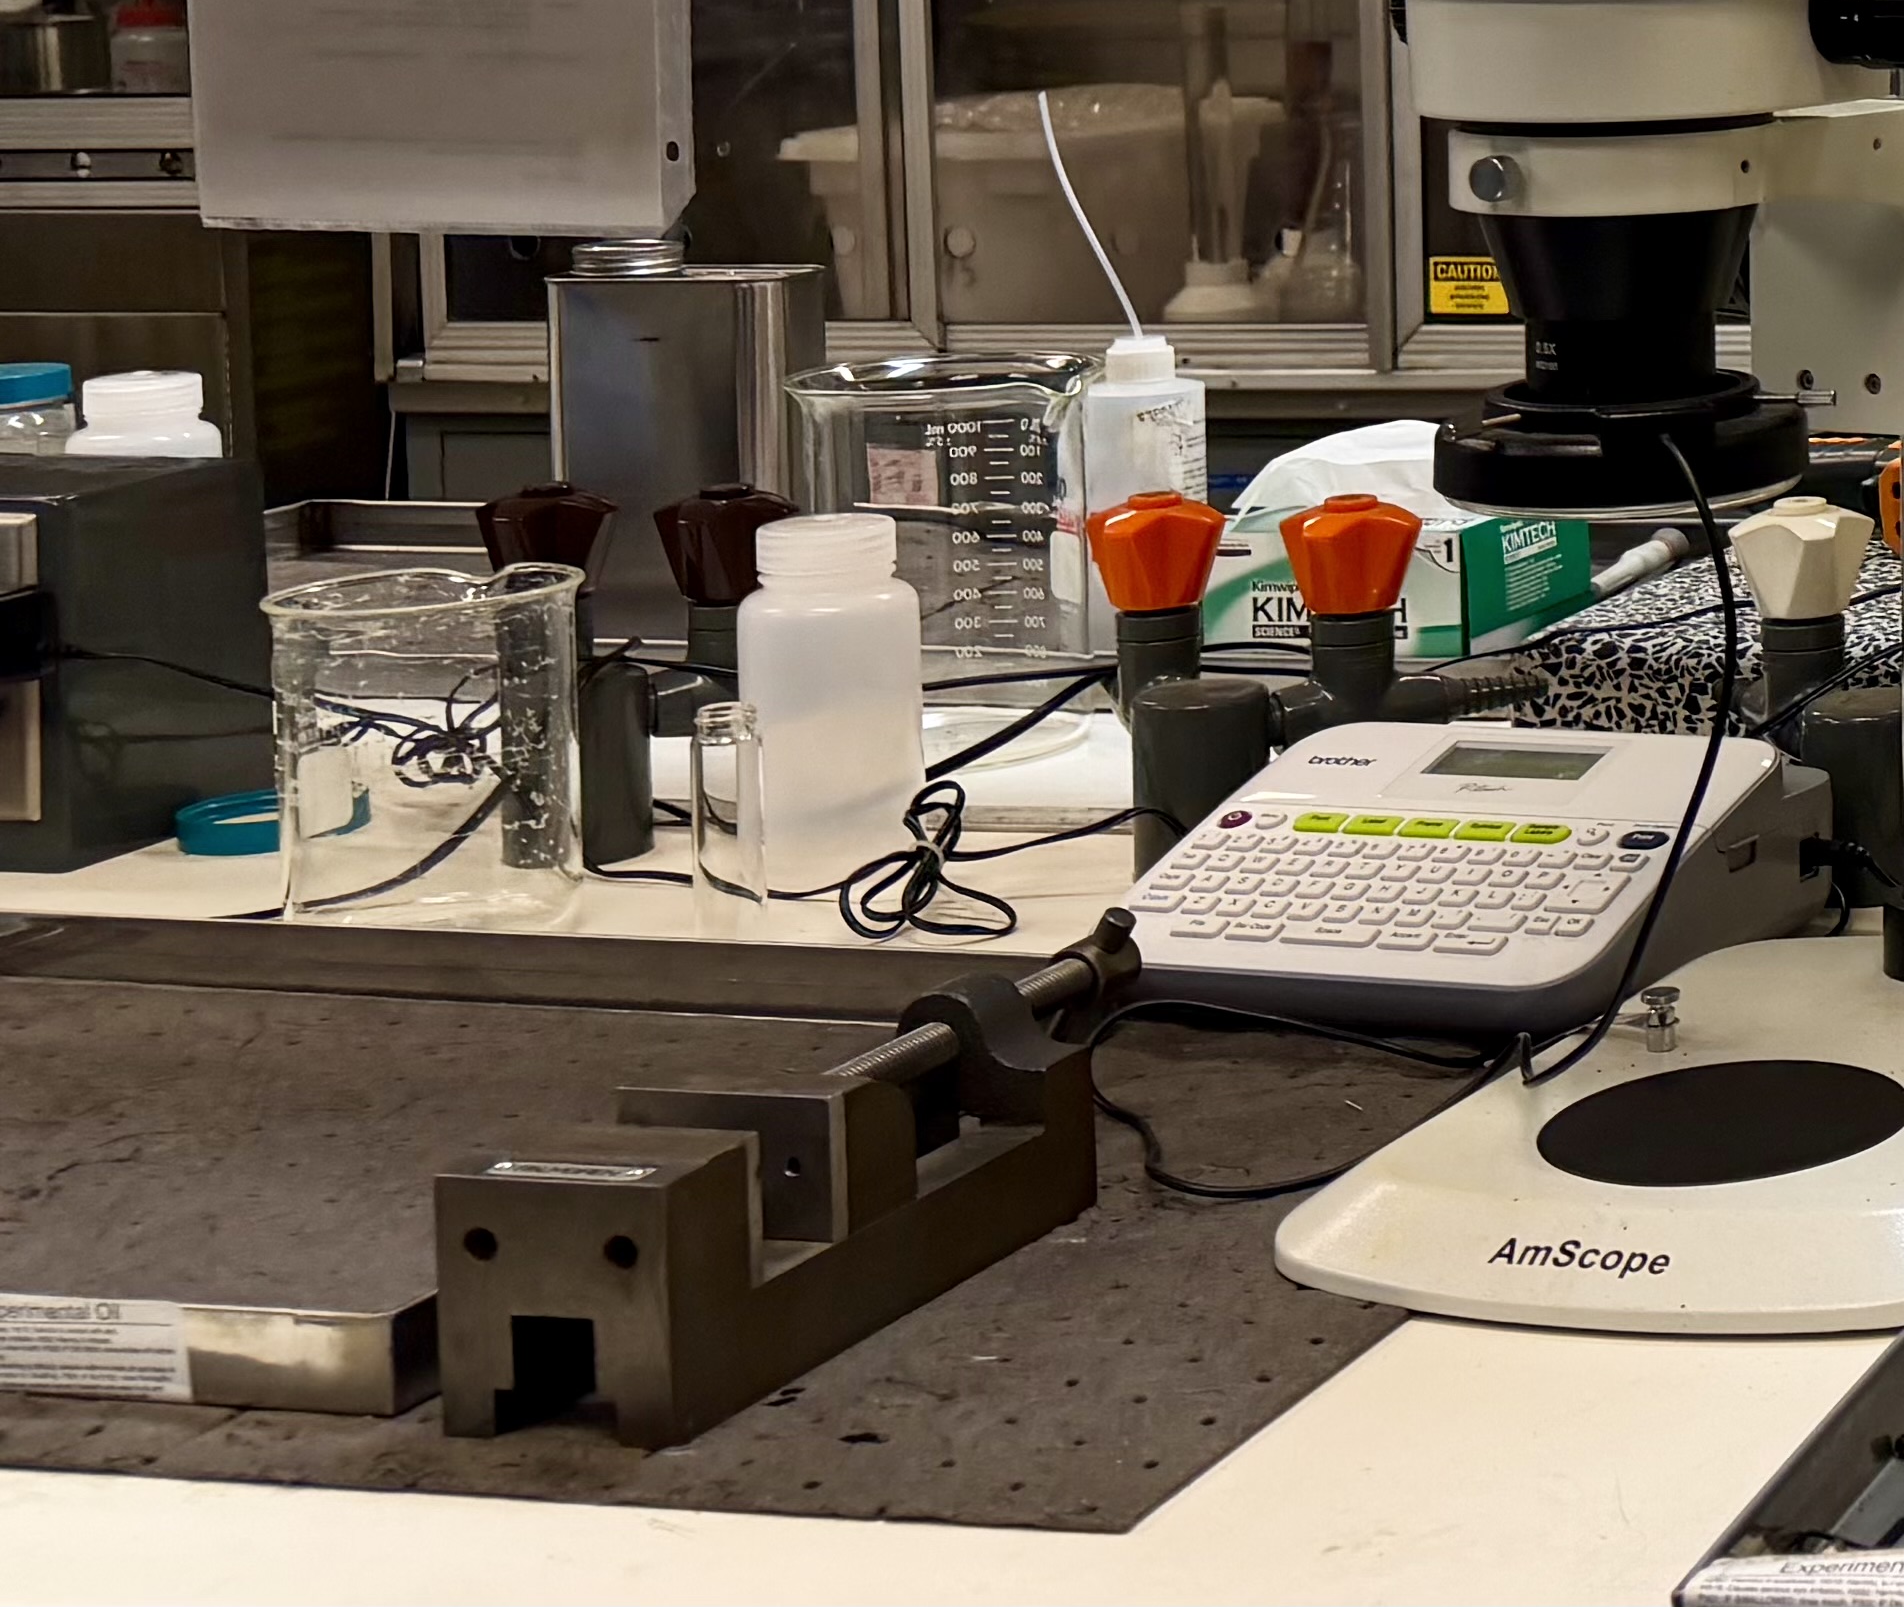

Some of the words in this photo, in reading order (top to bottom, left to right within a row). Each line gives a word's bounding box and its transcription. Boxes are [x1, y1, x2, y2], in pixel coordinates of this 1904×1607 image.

[1501, 520, 1557, 552] KIMTECH
[1307, 754, 1378, 769] brother
[1488, 1236, 1671, 1277] AmScope
